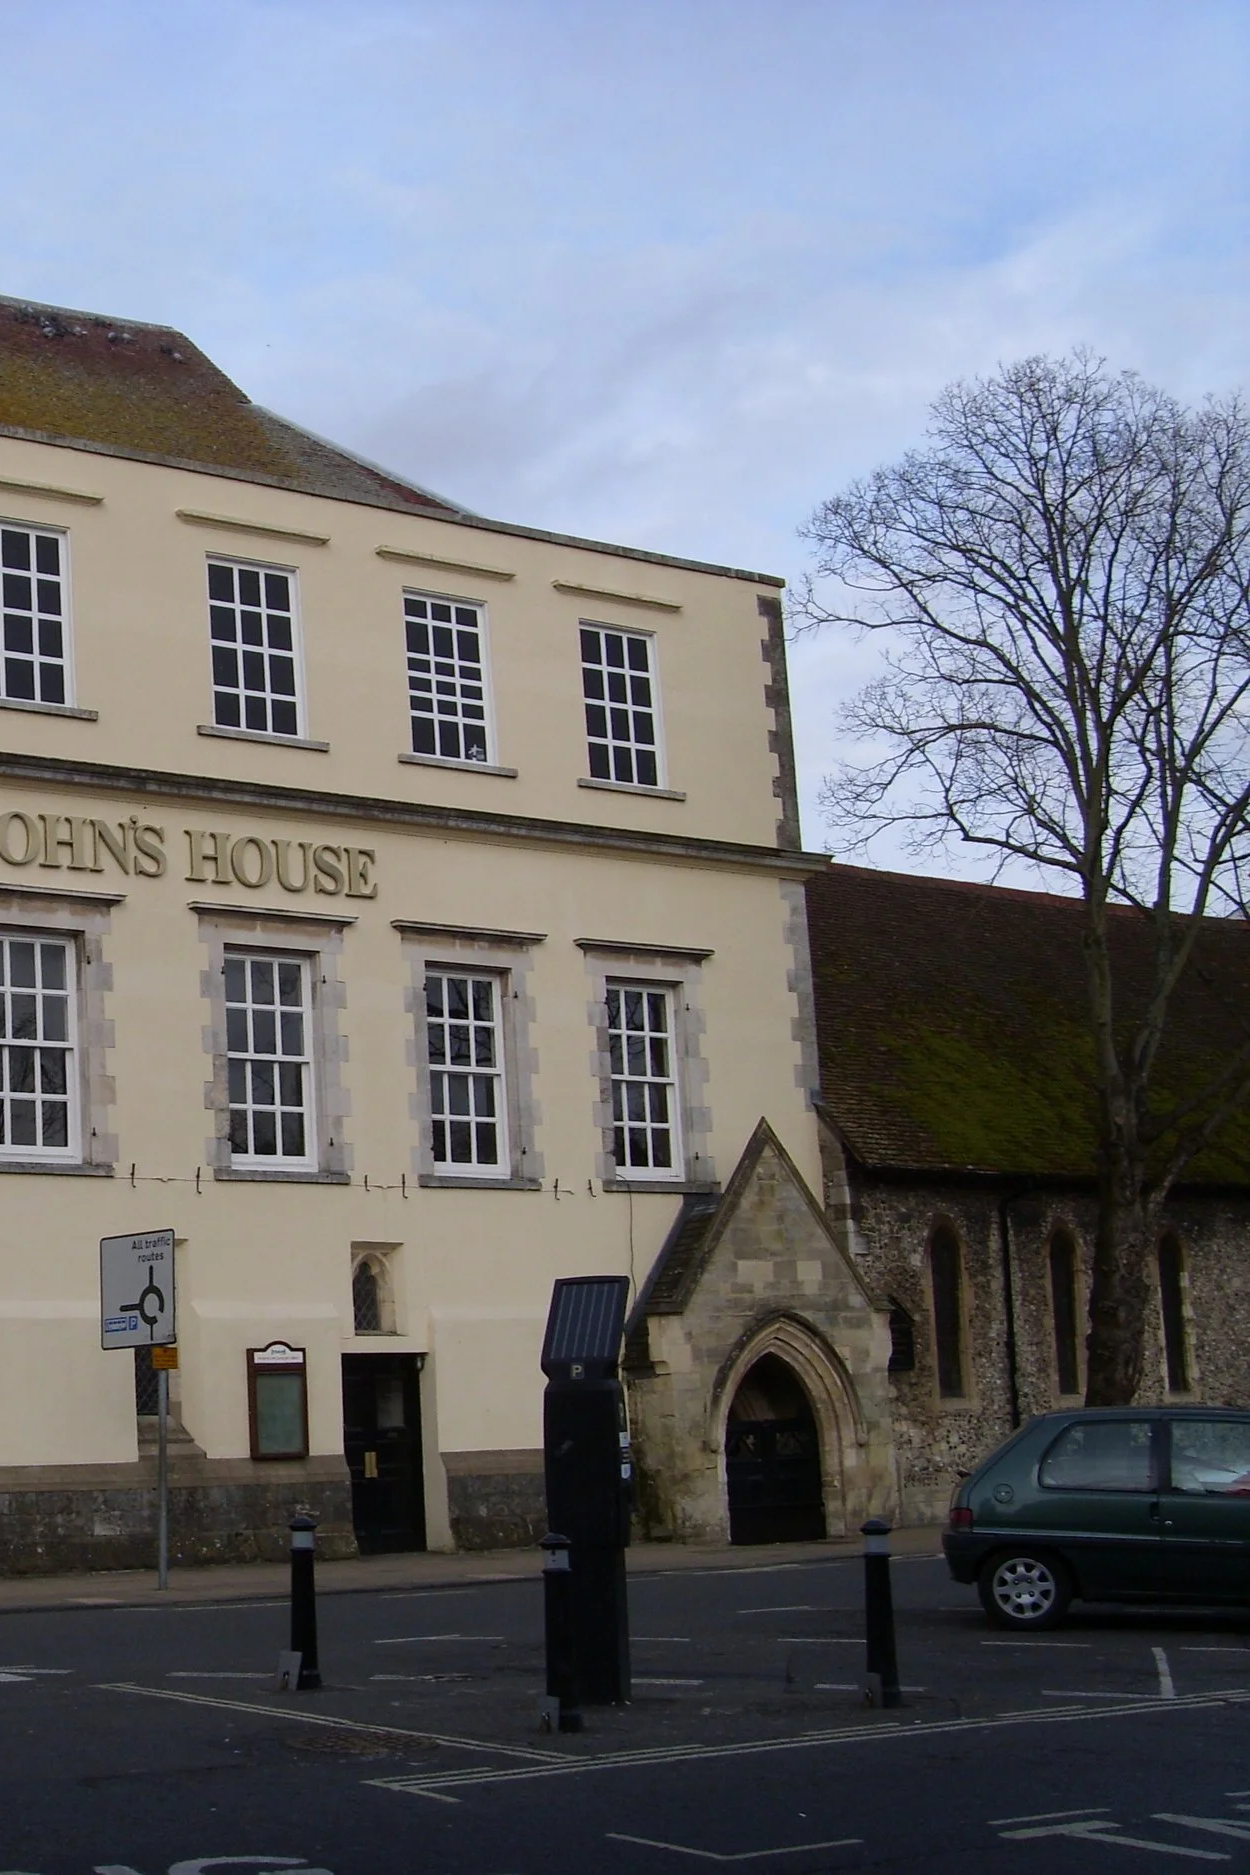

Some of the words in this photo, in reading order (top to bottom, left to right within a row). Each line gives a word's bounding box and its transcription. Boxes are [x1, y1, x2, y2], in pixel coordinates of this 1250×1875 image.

[184, 828, 379, 899] HOUSE
[131, 1240, 144, 1251] All
[145, 1237, 171, 1249] traffic
[137, 1251, 164, 1263] routes
[572, 1364, 583, 1378] P
